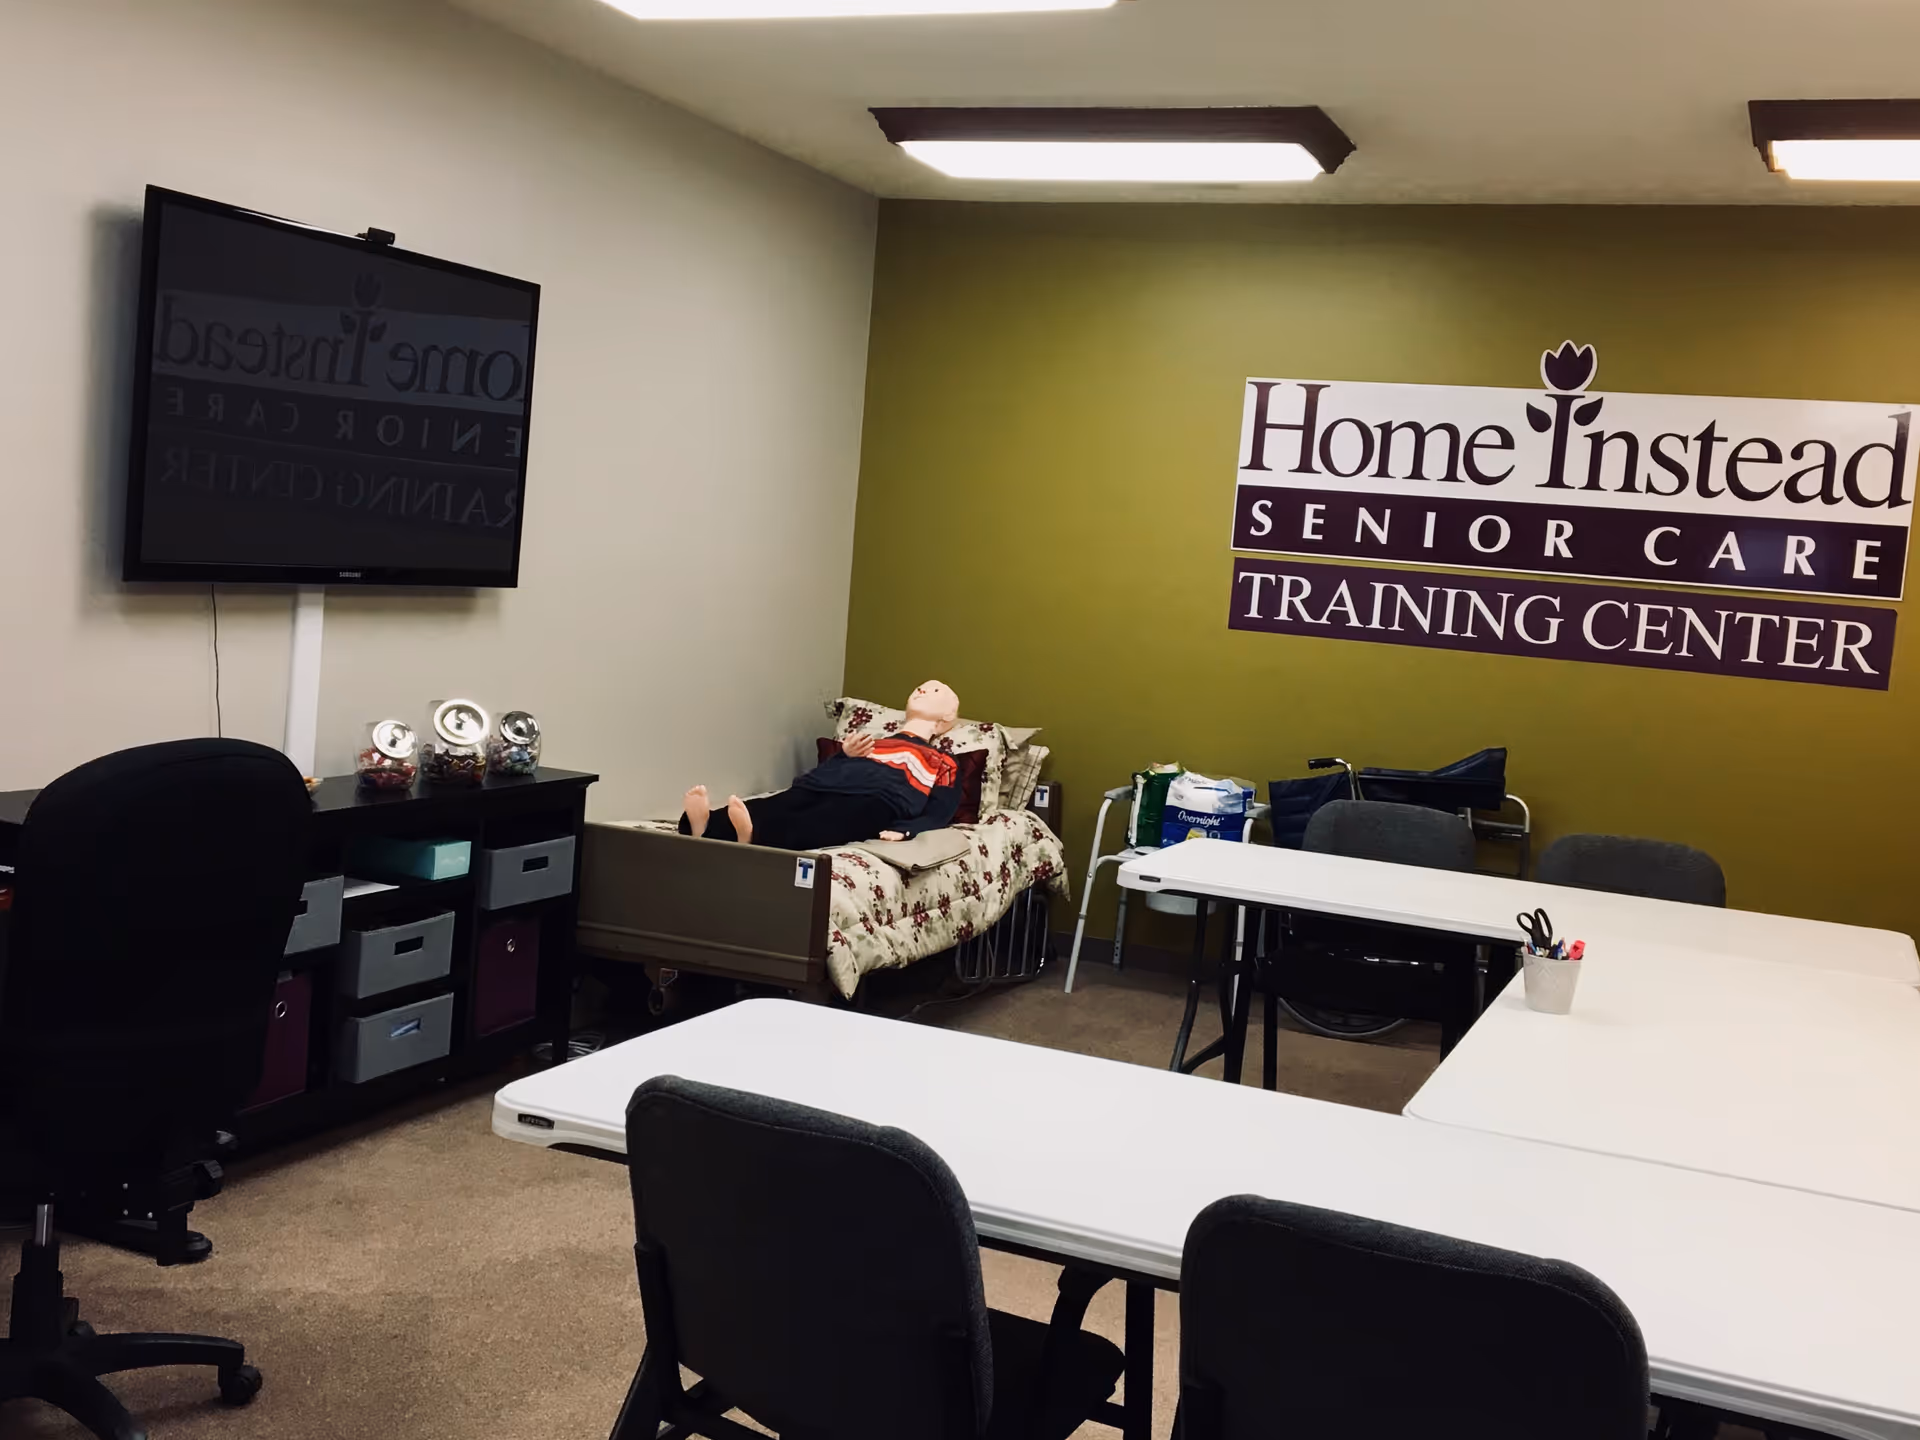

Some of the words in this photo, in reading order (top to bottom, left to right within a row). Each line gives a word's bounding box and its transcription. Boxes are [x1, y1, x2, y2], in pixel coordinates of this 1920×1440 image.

[1239, 381, 1516, 486] Home
[1534, 393, 1912, 509] Instead
[1248, 499, 1574, 559] SENIOR
[1642, 525, 1882, 581] CARE
[1238, 571, 1563, 645] TRAINING
[1582, 599, 1880, 675] CENTER
